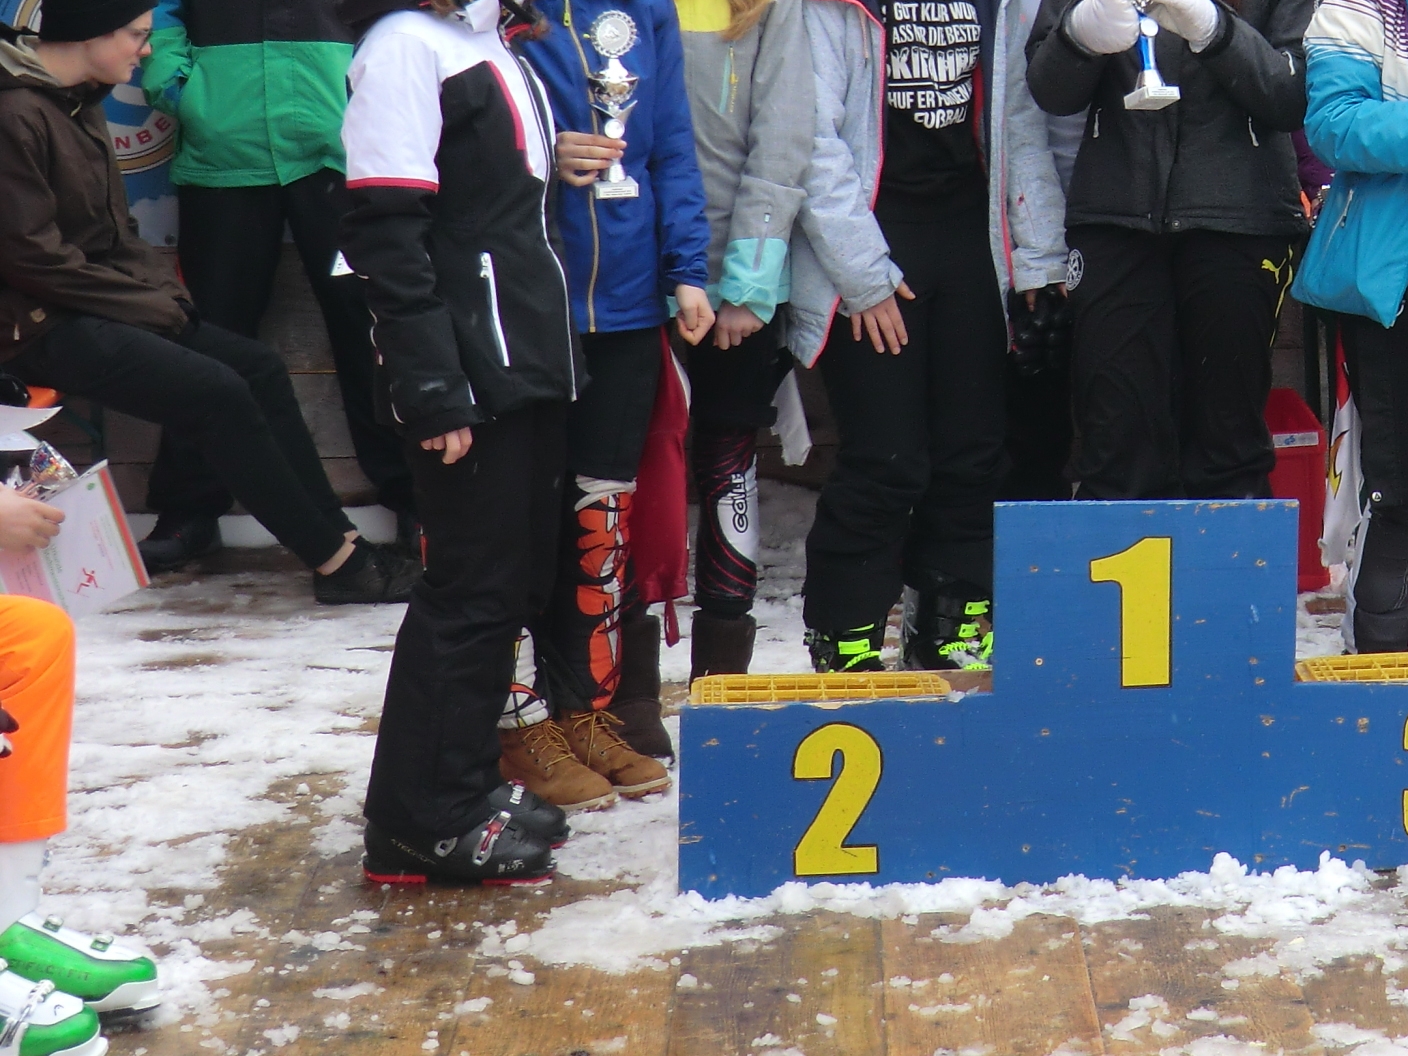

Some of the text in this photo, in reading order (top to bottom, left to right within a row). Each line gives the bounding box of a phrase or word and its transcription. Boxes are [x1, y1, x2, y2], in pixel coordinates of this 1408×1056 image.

[892, 24, 914, 44] ASS
[888, 91, 914, 110] HUF
[1089, 536, 1173, 689] 1
[792, 721, 884, 876] 2
